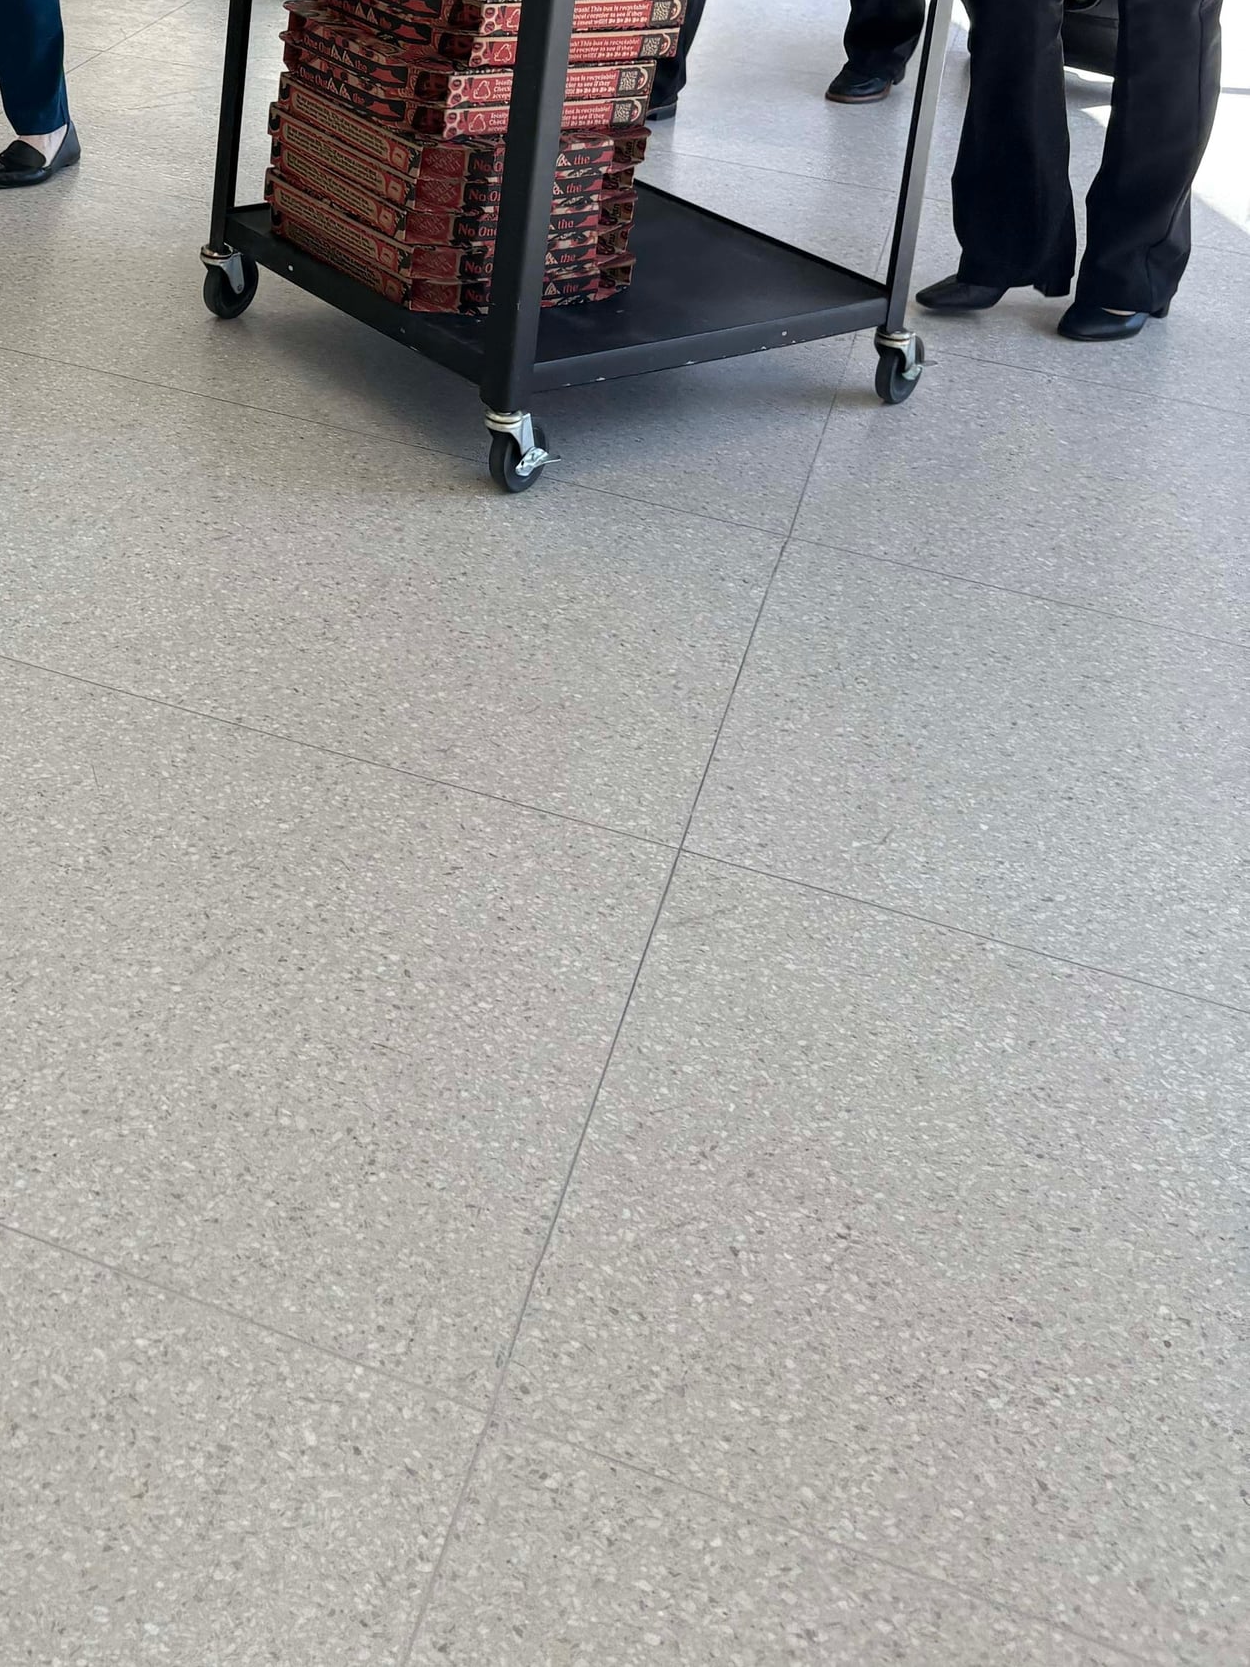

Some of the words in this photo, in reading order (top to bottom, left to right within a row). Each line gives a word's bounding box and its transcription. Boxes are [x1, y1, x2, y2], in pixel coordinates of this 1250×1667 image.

[574, 154, 591, 165] the
[473, 159, 491, 172] No
[468, 189, 487, 201] No
[558, 219, 574, 229] the
